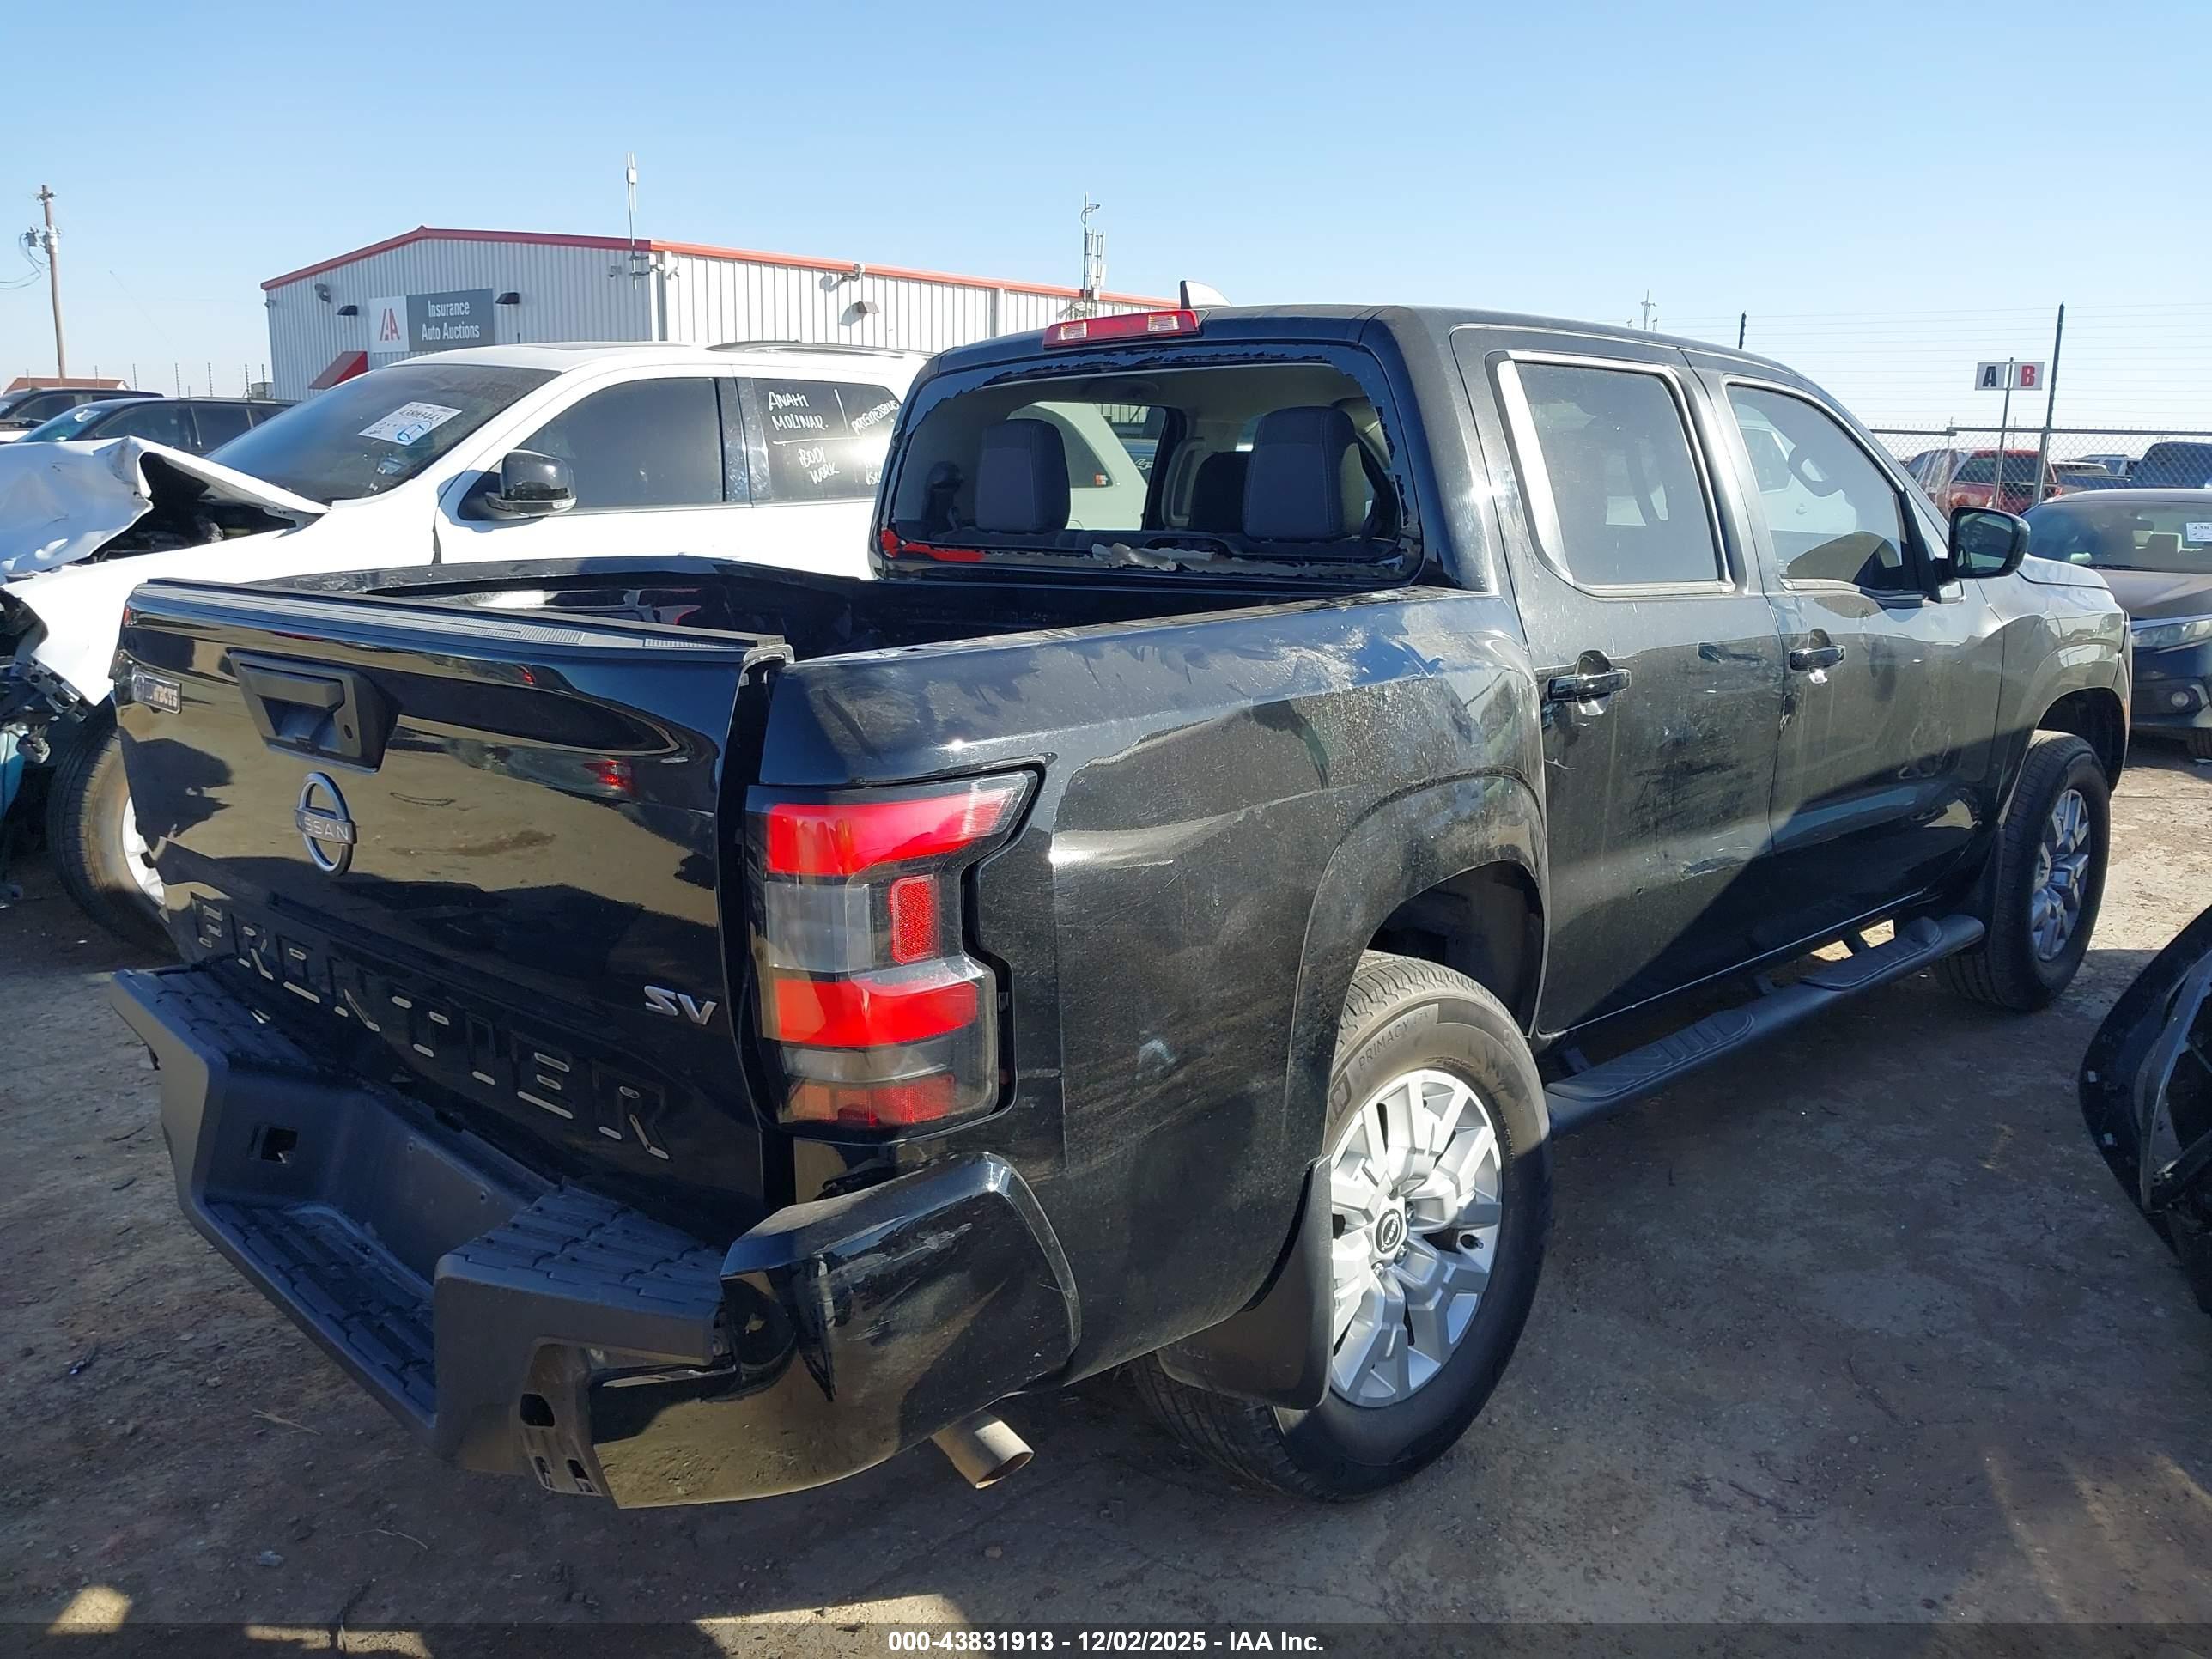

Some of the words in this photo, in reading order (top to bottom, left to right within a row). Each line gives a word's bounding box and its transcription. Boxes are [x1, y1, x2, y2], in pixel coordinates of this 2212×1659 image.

[428, 300, 470, 317] Insurance
[422, 323, 441, 341] Auto
[443, 321, 480, 339] Auctions
[1982, 366, 1996, 386] A
[2021, 366, 2035, 386] B
[809, 462, 840, 484] WORK
[644, 985, 718, 1025] SV
[190, 890, 673, 1162] FRONTIER
